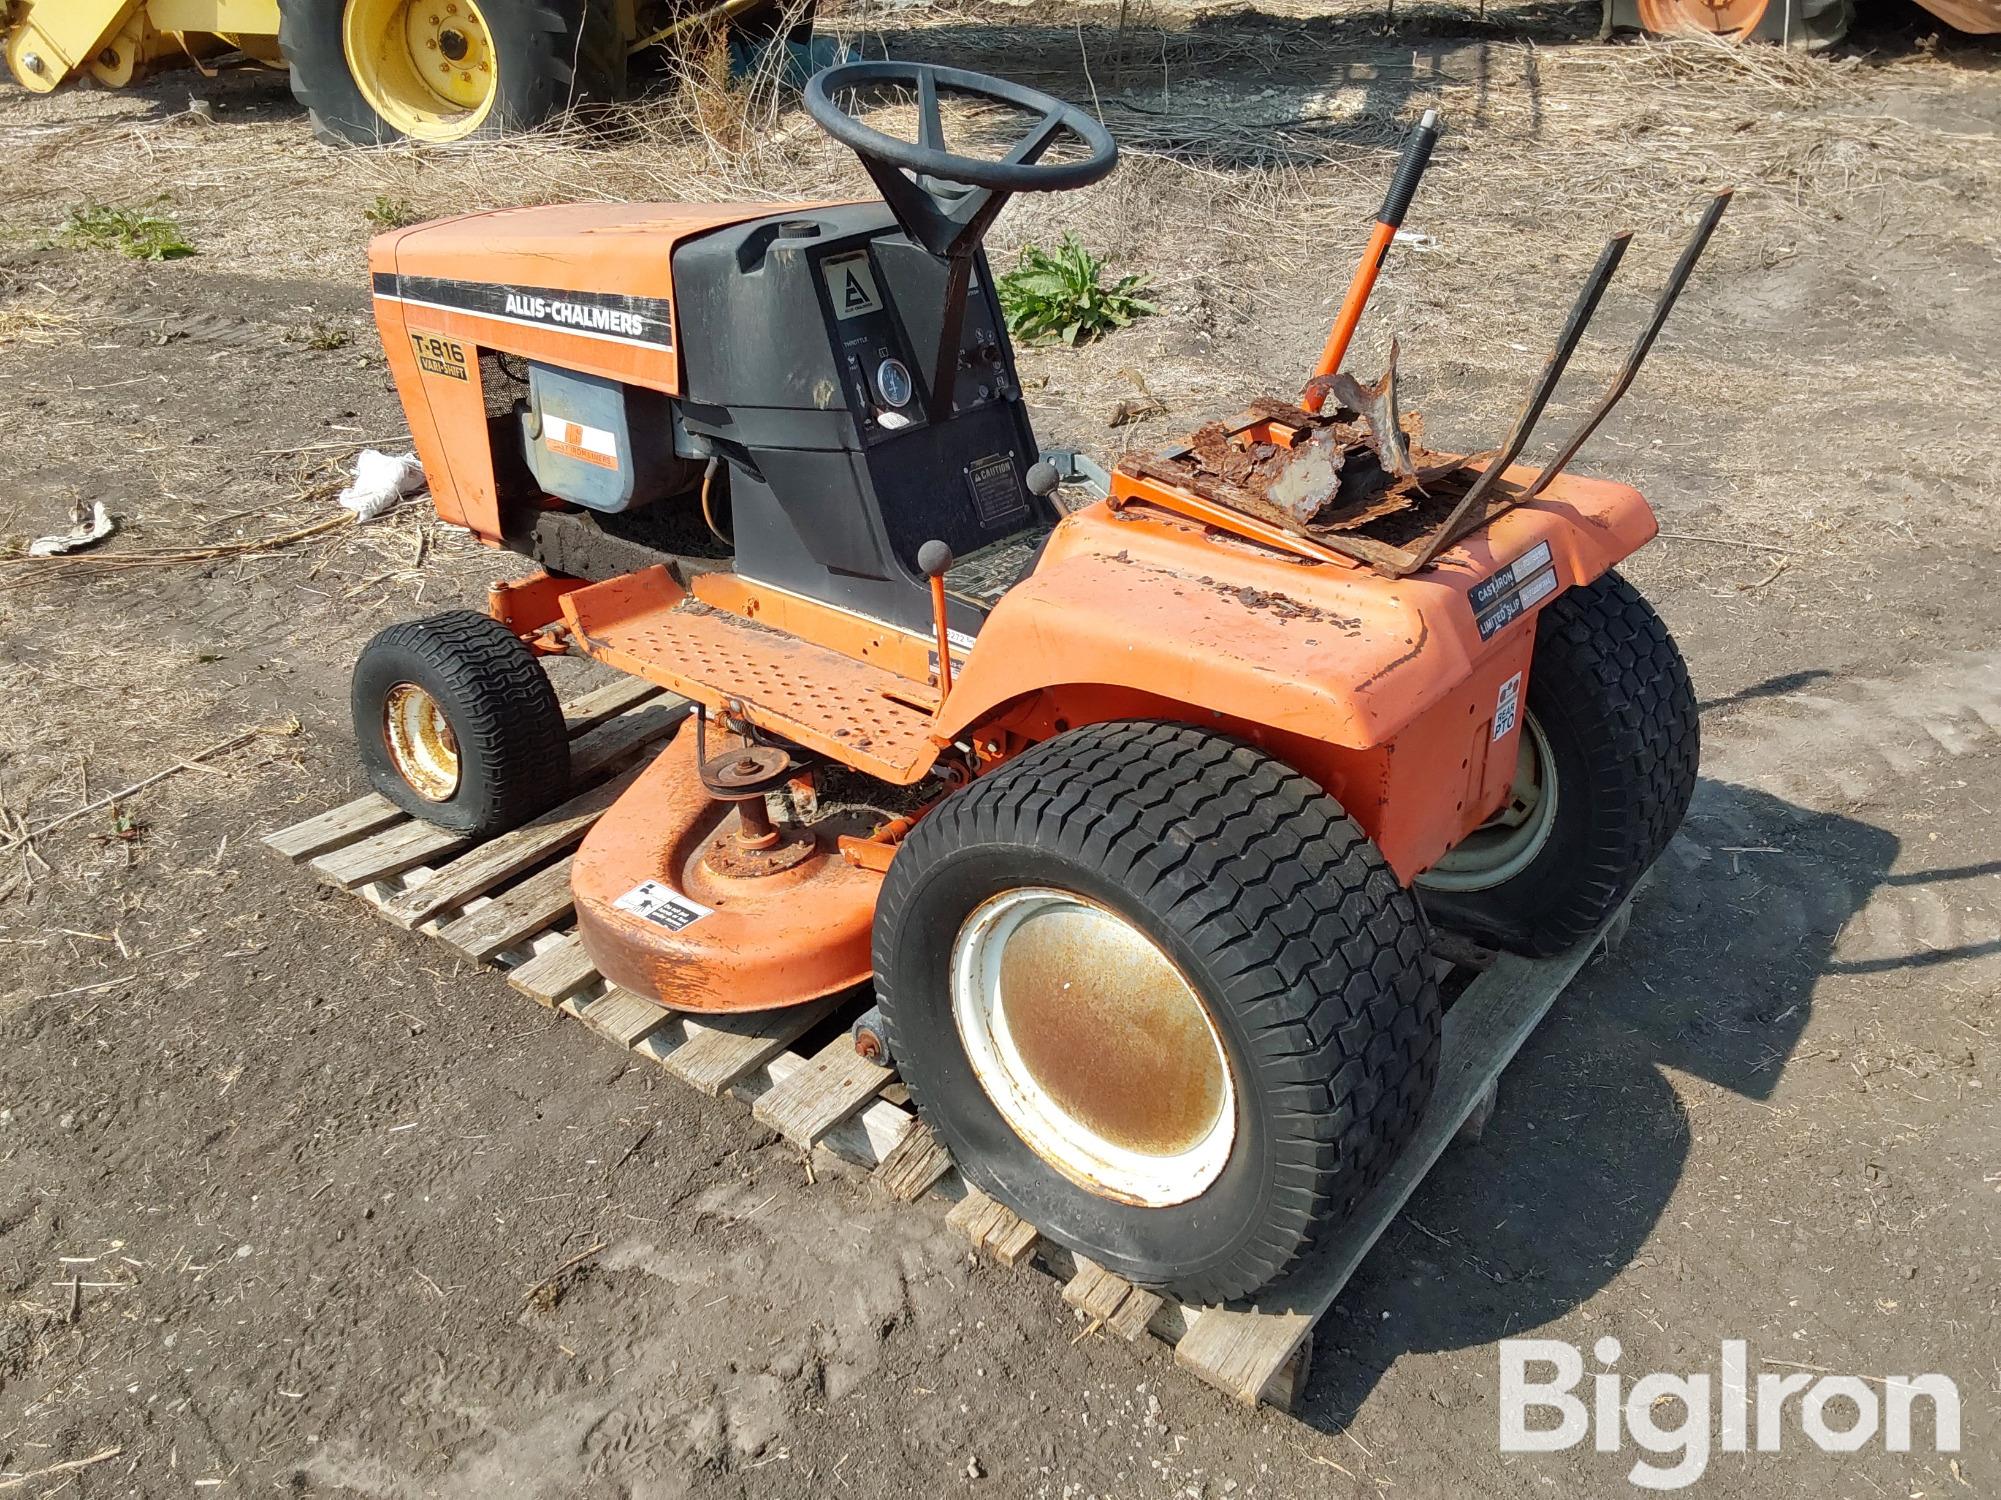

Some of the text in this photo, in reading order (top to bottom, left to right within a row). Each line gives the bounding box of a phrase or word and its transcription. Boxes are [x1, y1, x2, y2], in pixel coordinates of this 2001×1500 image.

[505, 294, 643, 336] ALLIS-CHALMERS
[980, 461, 1011, 480] CAUTION
[1477, 570, 1513, 602] CAST IRON
[1479, 598, 1520, 634] LIMITED SLIP
[1494, 713, 1514, 739] PTO
[1497, 702, 1515, 723] REAR
